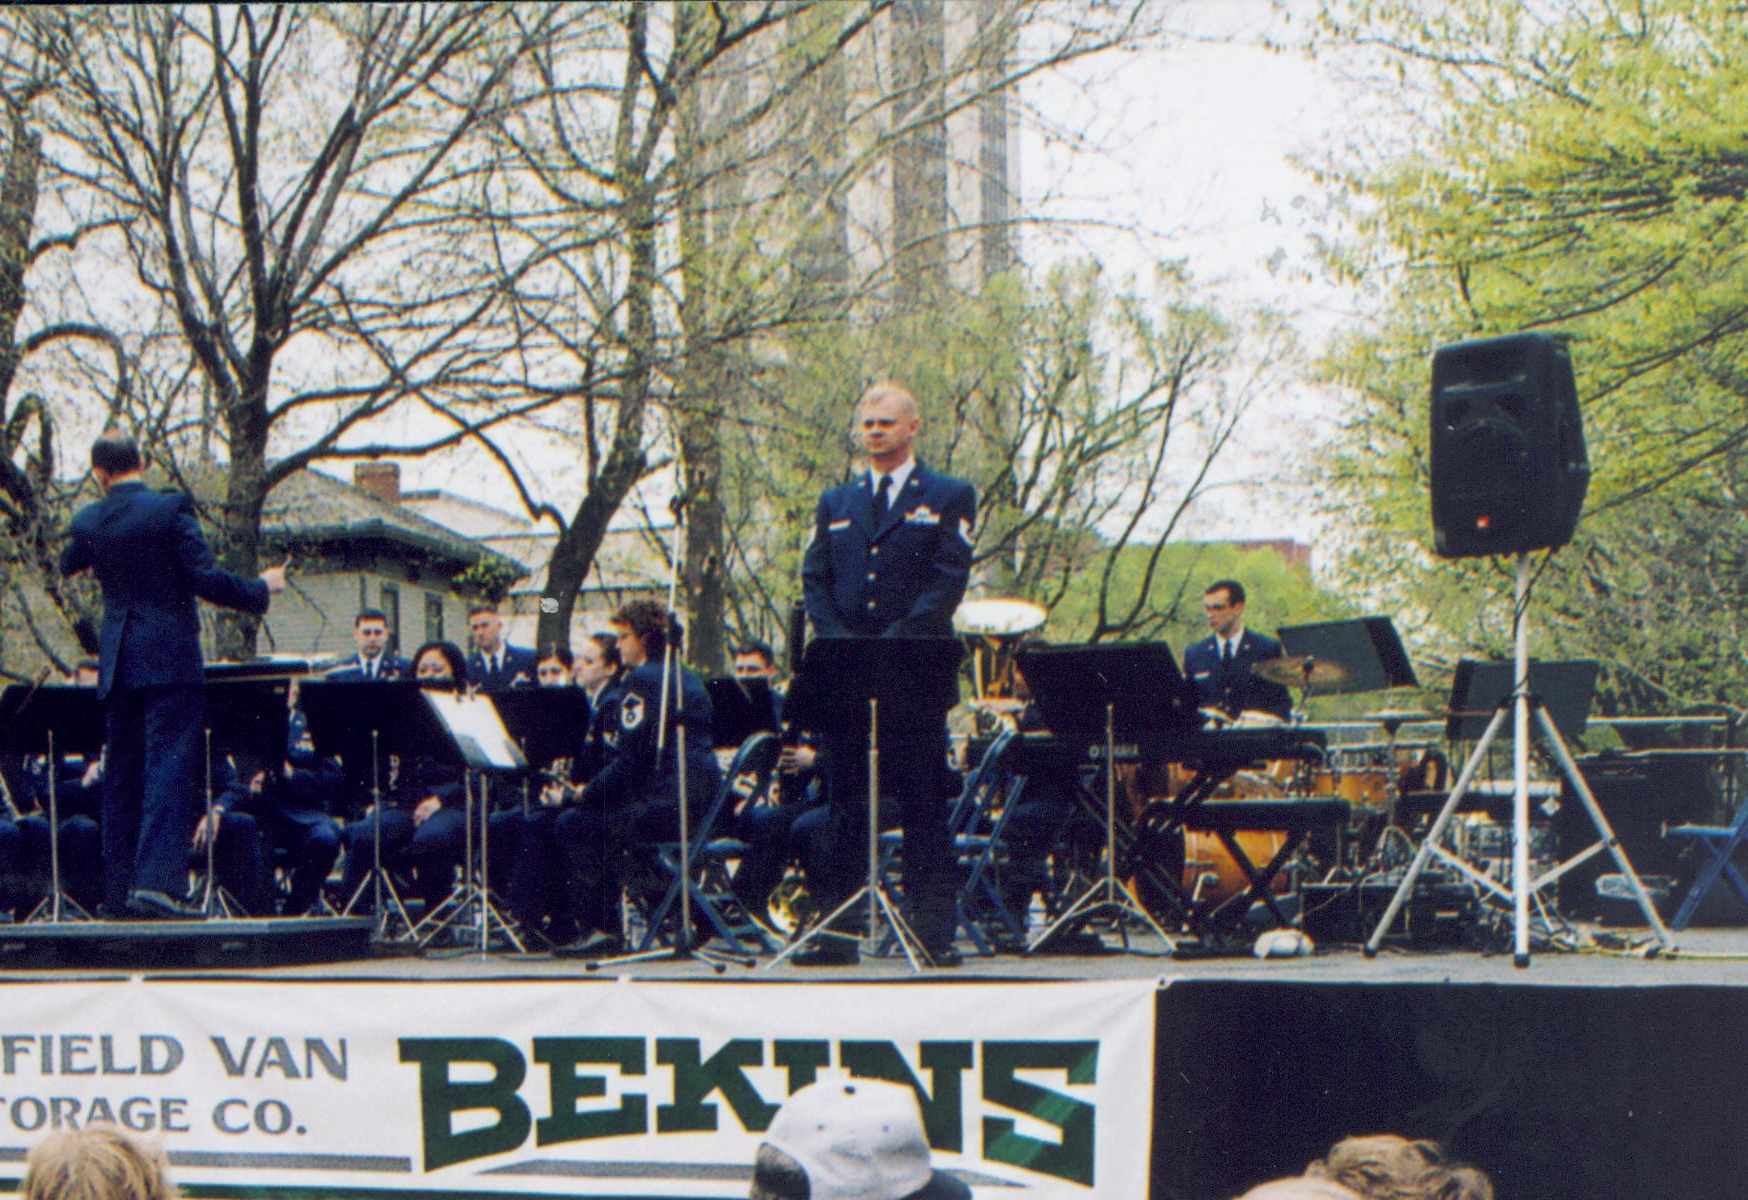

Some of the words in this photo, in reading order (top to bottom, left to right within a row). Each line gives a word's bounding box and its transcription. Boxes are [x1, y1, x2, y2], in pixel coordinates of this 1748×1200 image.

[210, 1036, 349, 1082] VAN
[212, 1099, 309, 1135] CO.
[397, 1036, 1100, 1189] BEKINS
